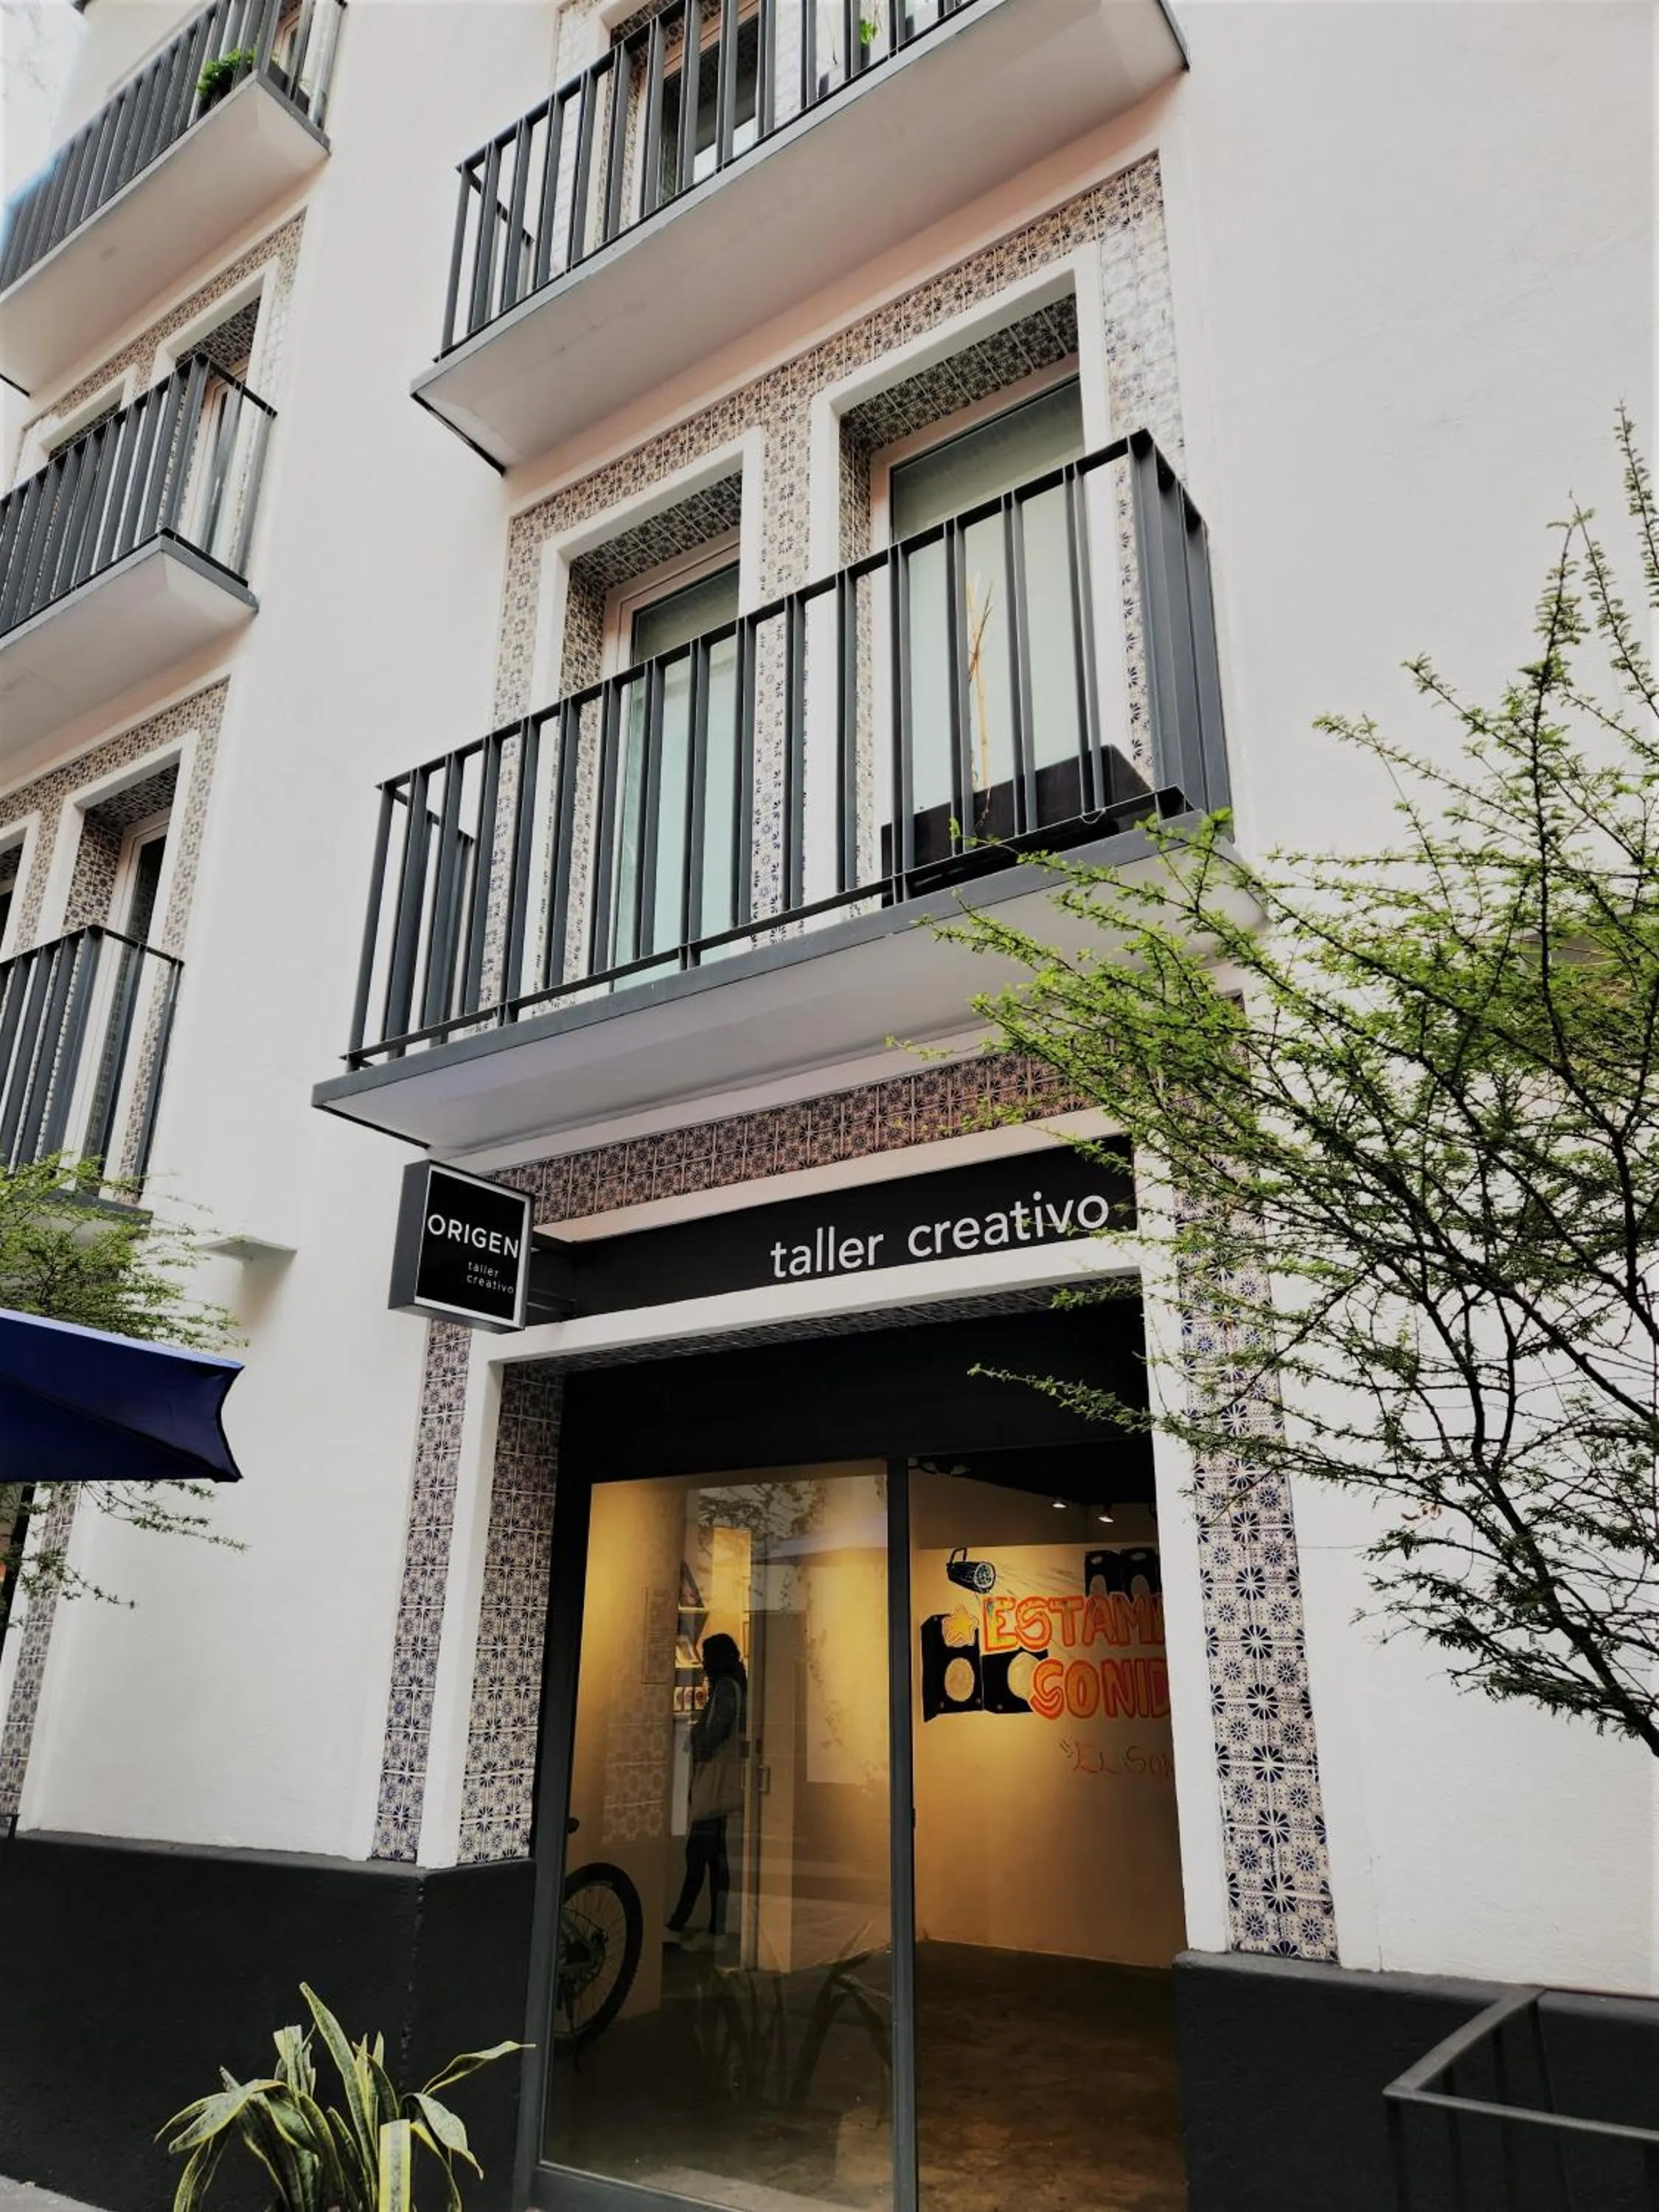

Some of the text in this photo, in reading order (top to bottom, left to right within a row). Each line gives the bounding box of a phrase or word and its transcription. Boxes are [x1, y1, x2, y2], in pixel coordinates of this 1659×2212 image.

[428, 1214, 519, 1259] ORIGEN
[771, 1192, 1109, 1278] taller creativo
[467, 1274, 515, 1294] creativo
[468, 1261, 499, 1276] taller
